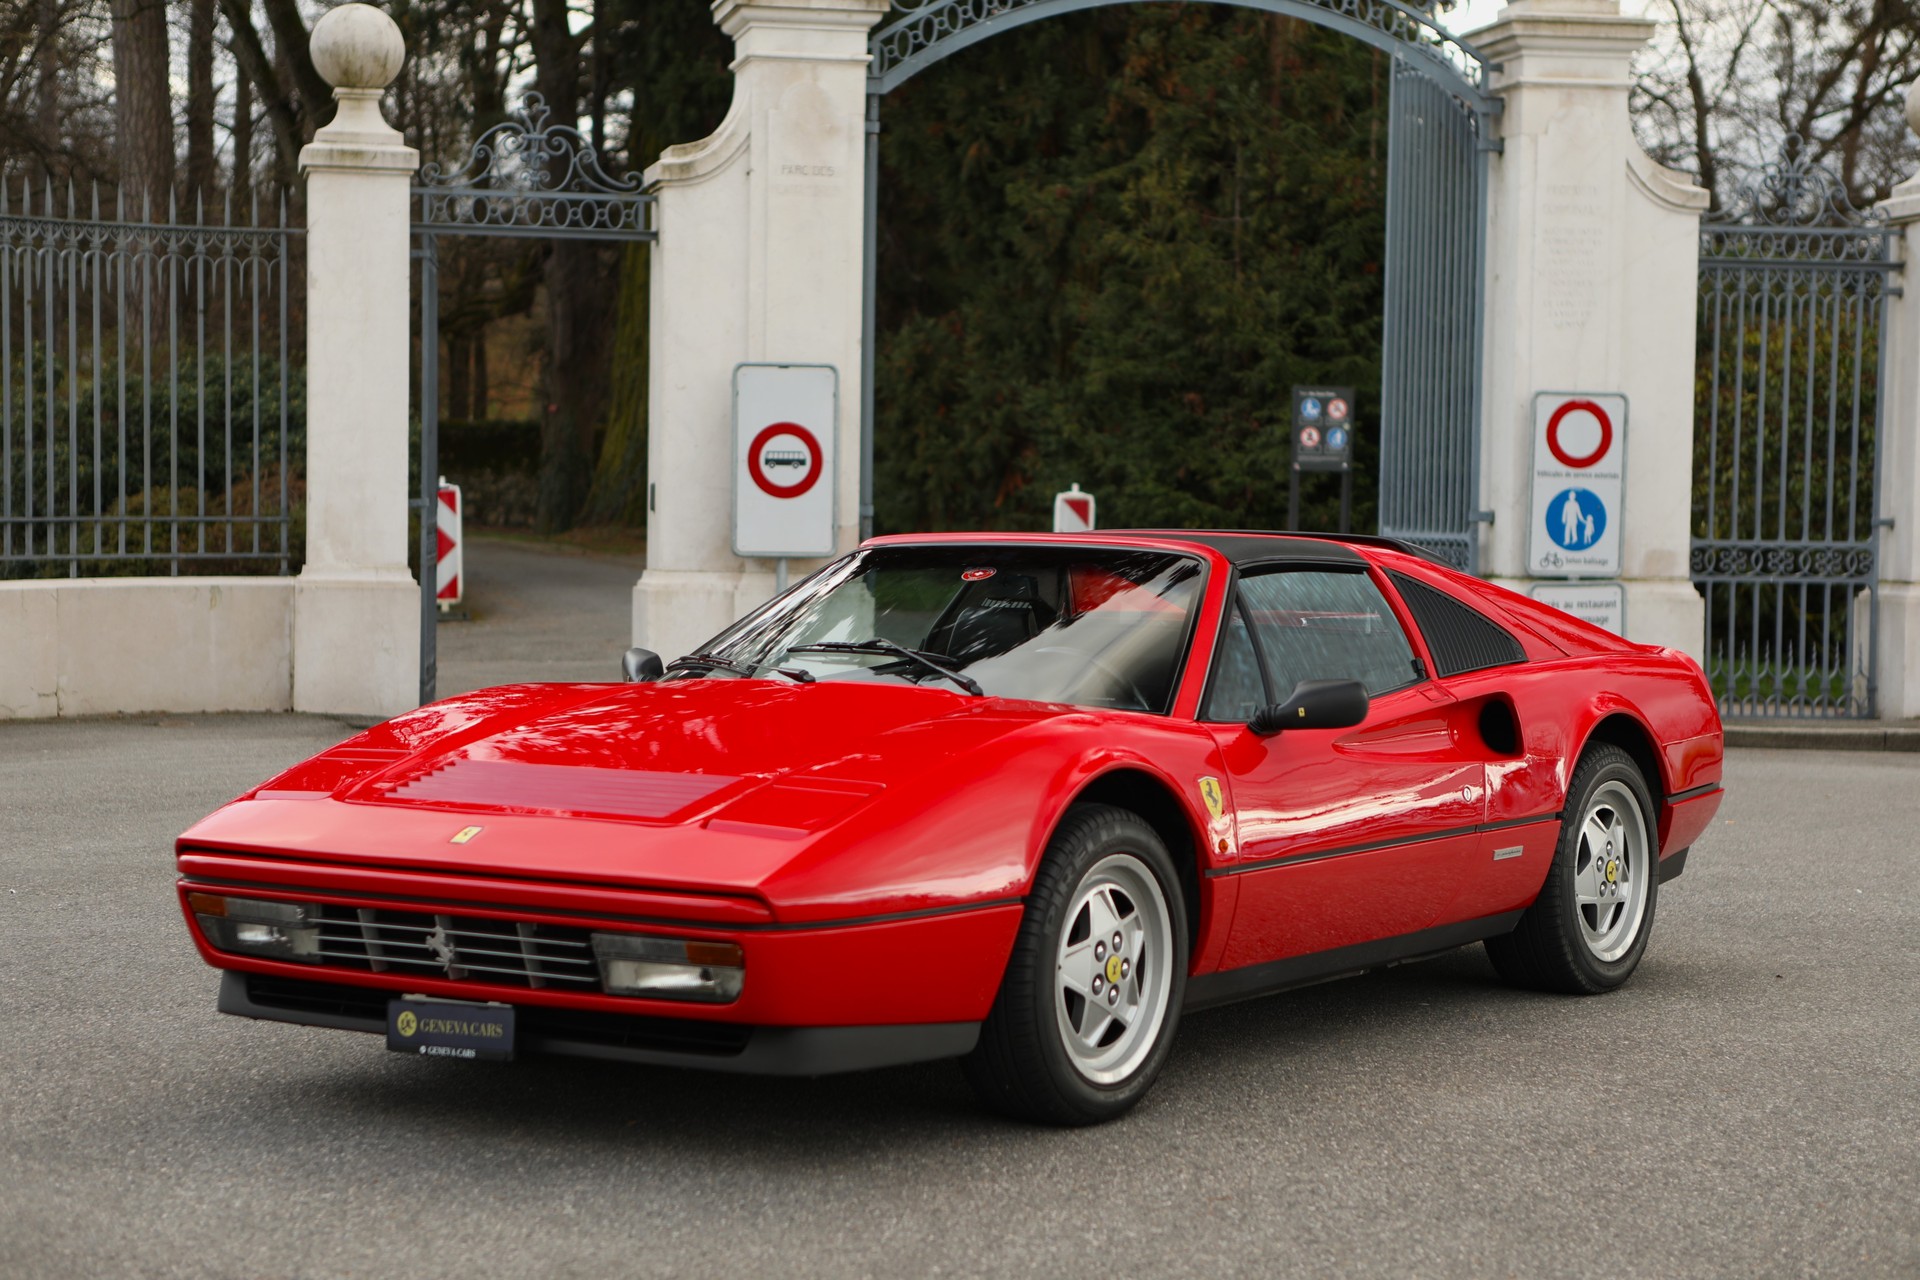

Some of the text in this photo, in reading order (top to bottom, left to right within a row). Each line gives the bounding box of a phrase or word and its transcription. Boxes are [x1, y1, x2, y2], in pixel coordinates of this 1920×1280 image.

[1576, 599, 1617, 609] restaurant
[1595, 755, 1630, 770] PIRELLI
[420, 1018, 469, 1036] GENEVA
[470, 1021, 503, 1038] CARS
[427, 1046, 477, 1059] GENEVA CARS
